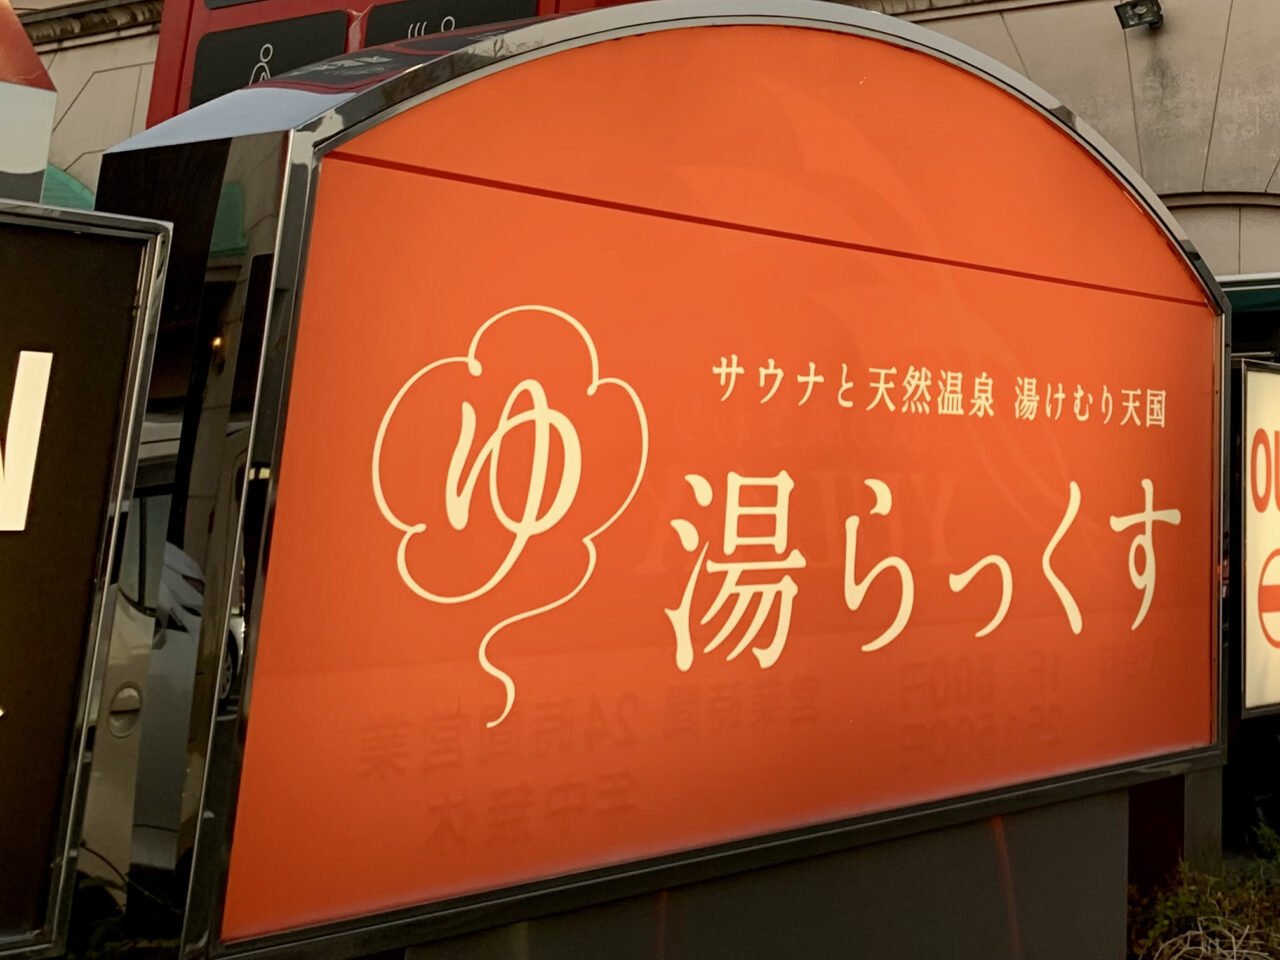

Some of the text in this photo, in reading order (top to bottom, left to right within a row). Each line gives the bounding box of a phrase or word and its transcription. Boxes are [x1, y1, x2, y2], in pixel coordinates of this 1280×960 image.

[712, 354, 1168, 429] サウナと天然温泉 湯けむり天国
[664, 469, 1182, 671] 湯らっくす
